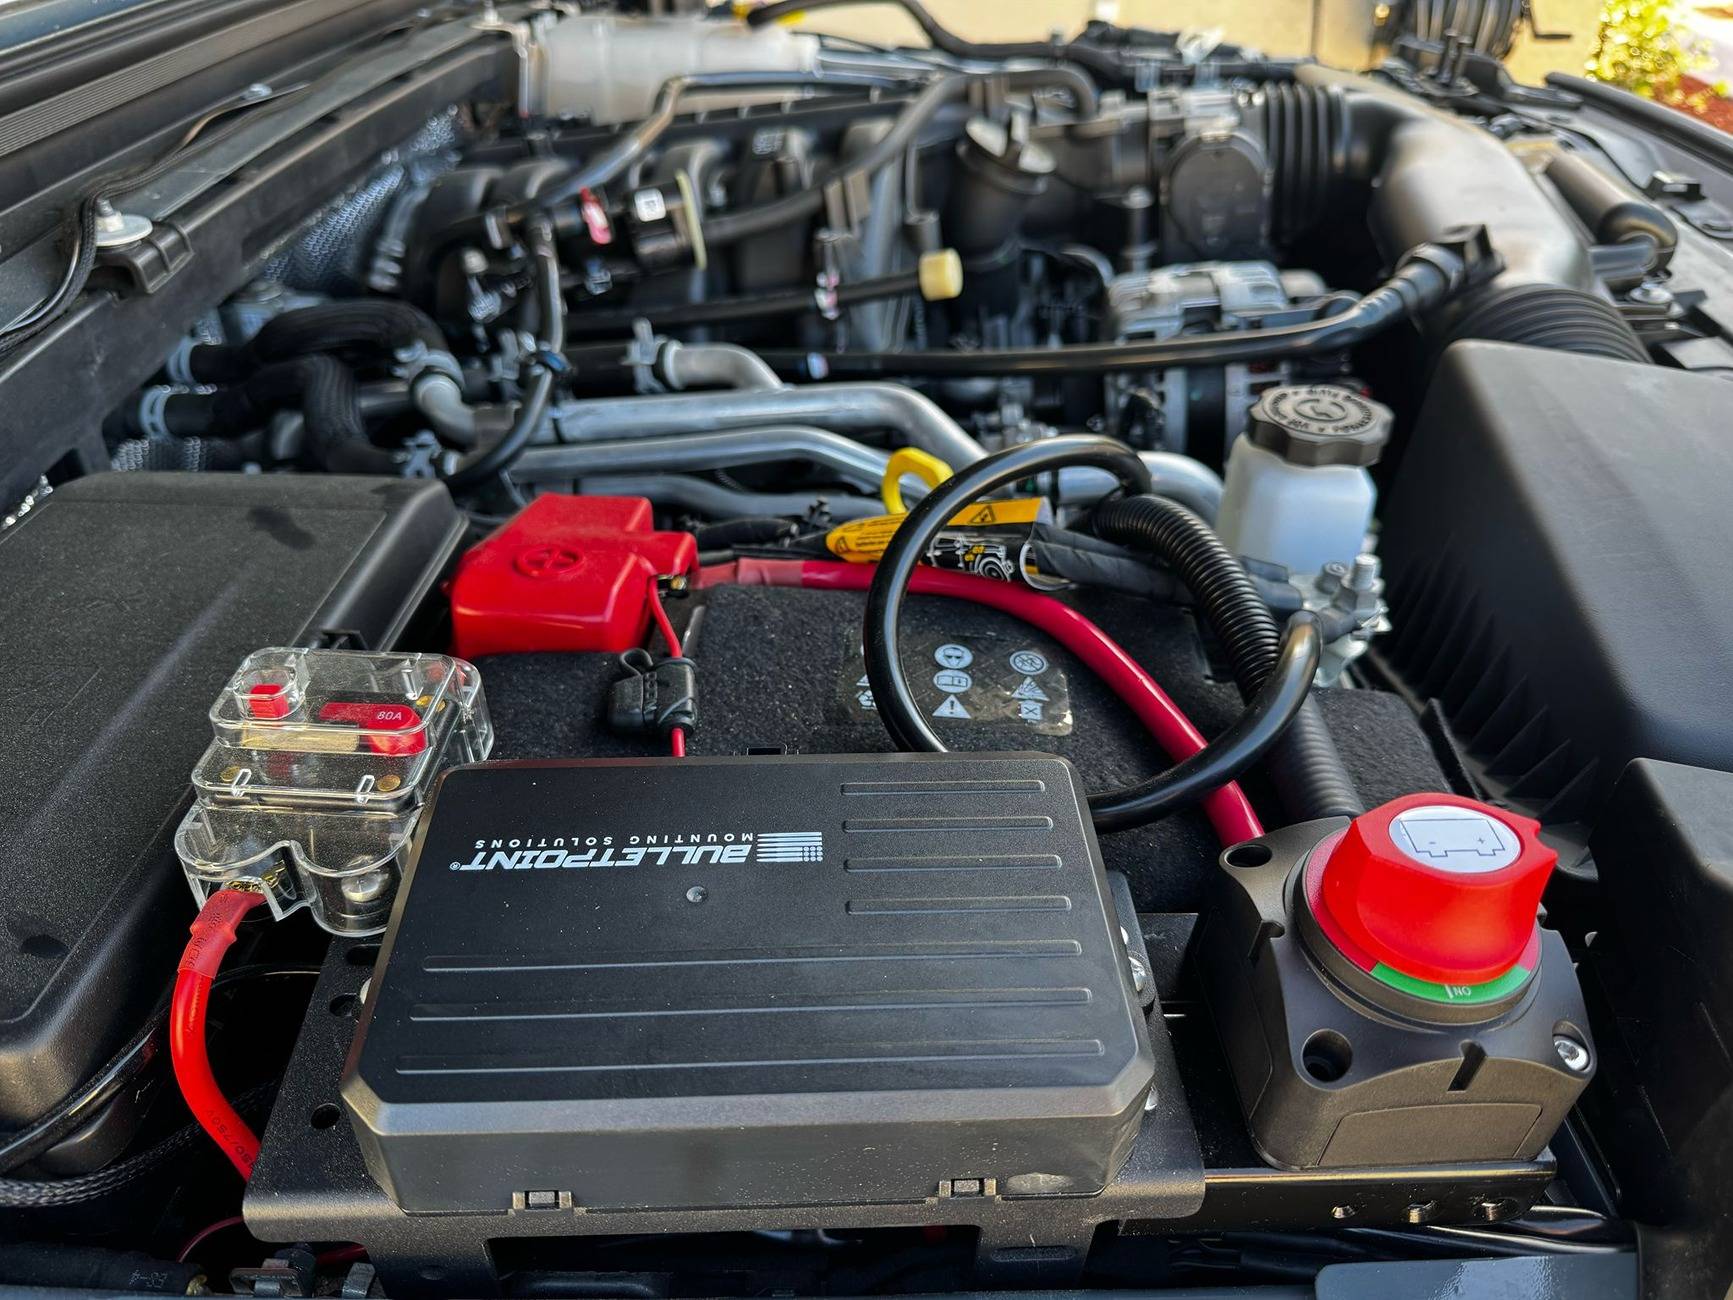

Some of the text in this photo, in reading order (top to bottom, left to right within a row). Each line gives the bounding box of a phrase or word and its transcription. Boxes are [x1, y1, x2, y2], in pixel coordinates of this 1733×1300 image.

[377, 711, 402, 721] 80A
[475, 832, 754, 849] MOUNTING SOLUTIONS
